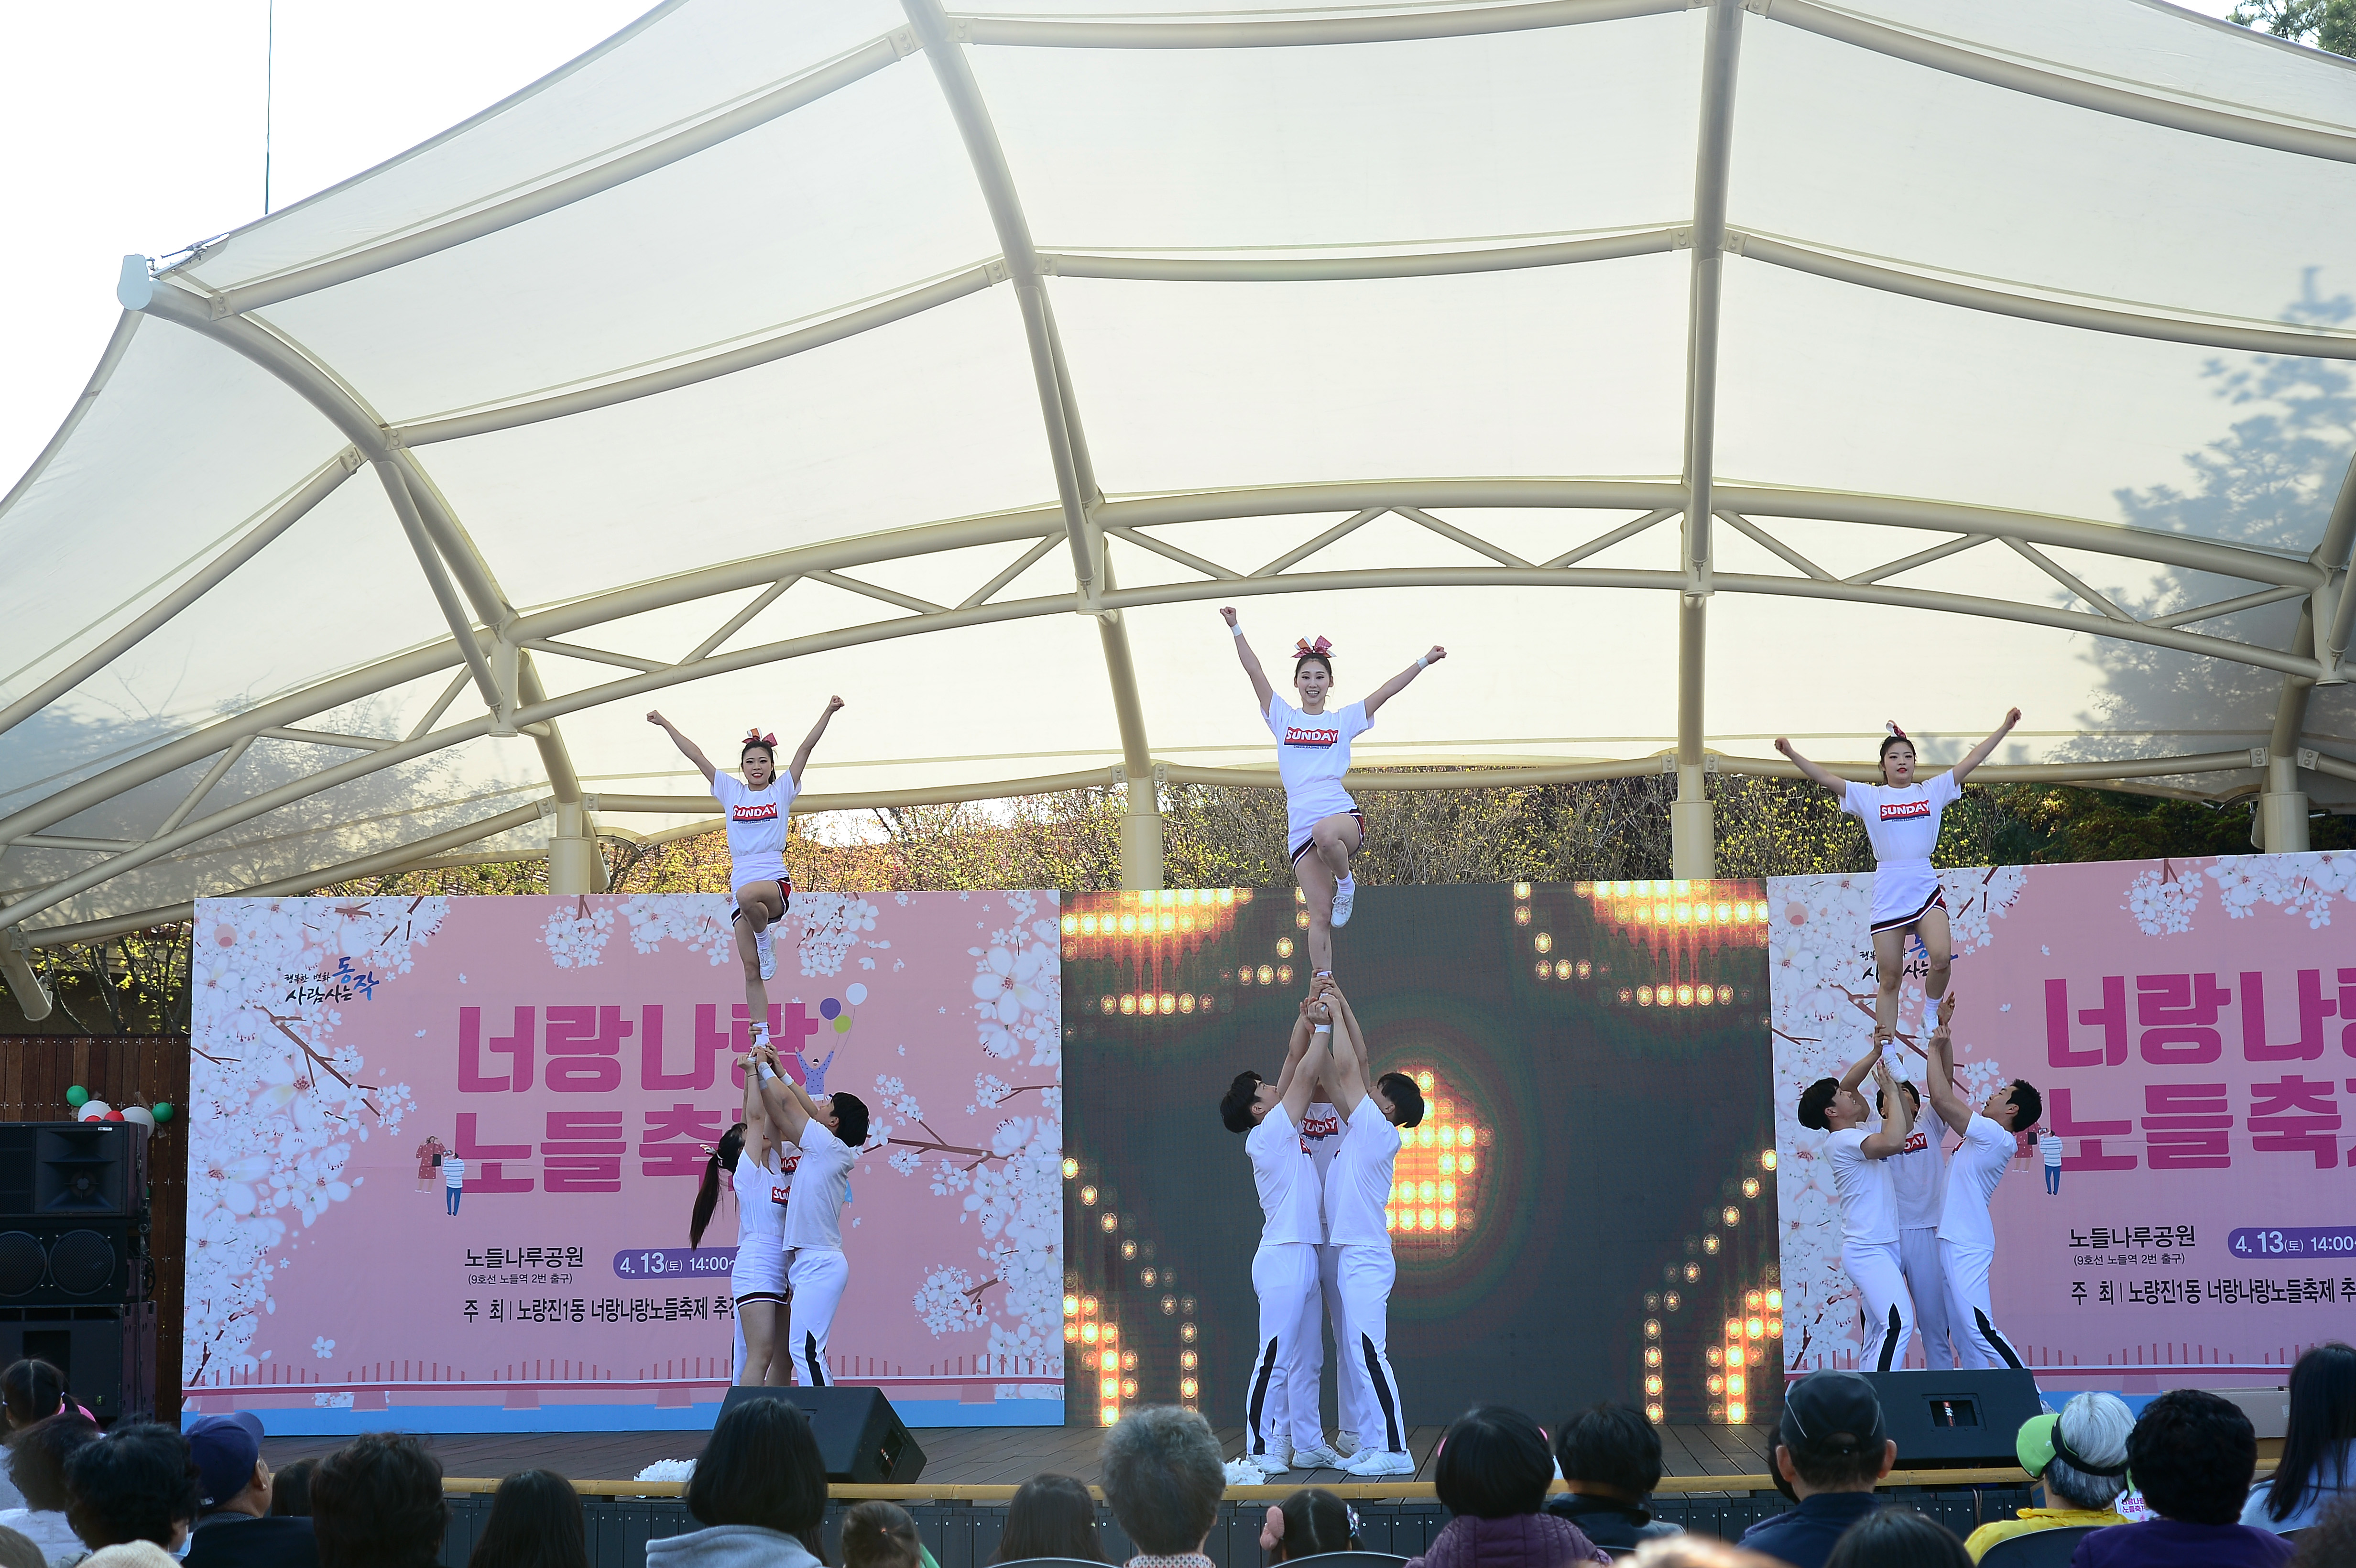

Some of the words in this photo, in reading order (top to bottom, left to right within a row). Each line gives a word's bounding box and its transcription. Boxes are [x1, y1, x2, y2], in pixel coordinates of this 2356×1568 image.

[1286, 730, 1338, 742] SUNDAY
[733, 805, 776, 817] SUNDAY
[1881, 802, 1930, 817] SUNDAY
[284, 973, 309, 984] 행복한
[313, 971, 331, 982] 변화
[2044, 968, 2356, 1068] 너랑나
[2049, 1075, 2356, 1172] 노들축
[456, 1104, 742, 1193] 노들축
[2069, 1225, 2196, 1249] 노들나루공원
[2311, 1235, 2356, 1252] 14:00
[464, 1246, 583, 1268] 노들나루공원
[2073, 1254, 2104, 1266] (9호선
[2107, 1254, 2138, 1265] 노들역
[2141, 1253, 2157, 1264] 2번
[2161, 1253, 2185, 1265] 출구)
[468, 1274, 496, 1285] (9호선
[499, 1274, 528, 1284] 노들역
[531, 1273, 546, 1284] 2번
[550, 1273, 573, 1284] 출구)
[2128, 1279, 2201, 1305] 노량진1동
[2207, 1277, 2335, 1304] 너랑나랑노들축제
[517, 1298, 586, 1323] 노량진1동
[591, 1296, 708, 1322] 너랑나랑노들축제
